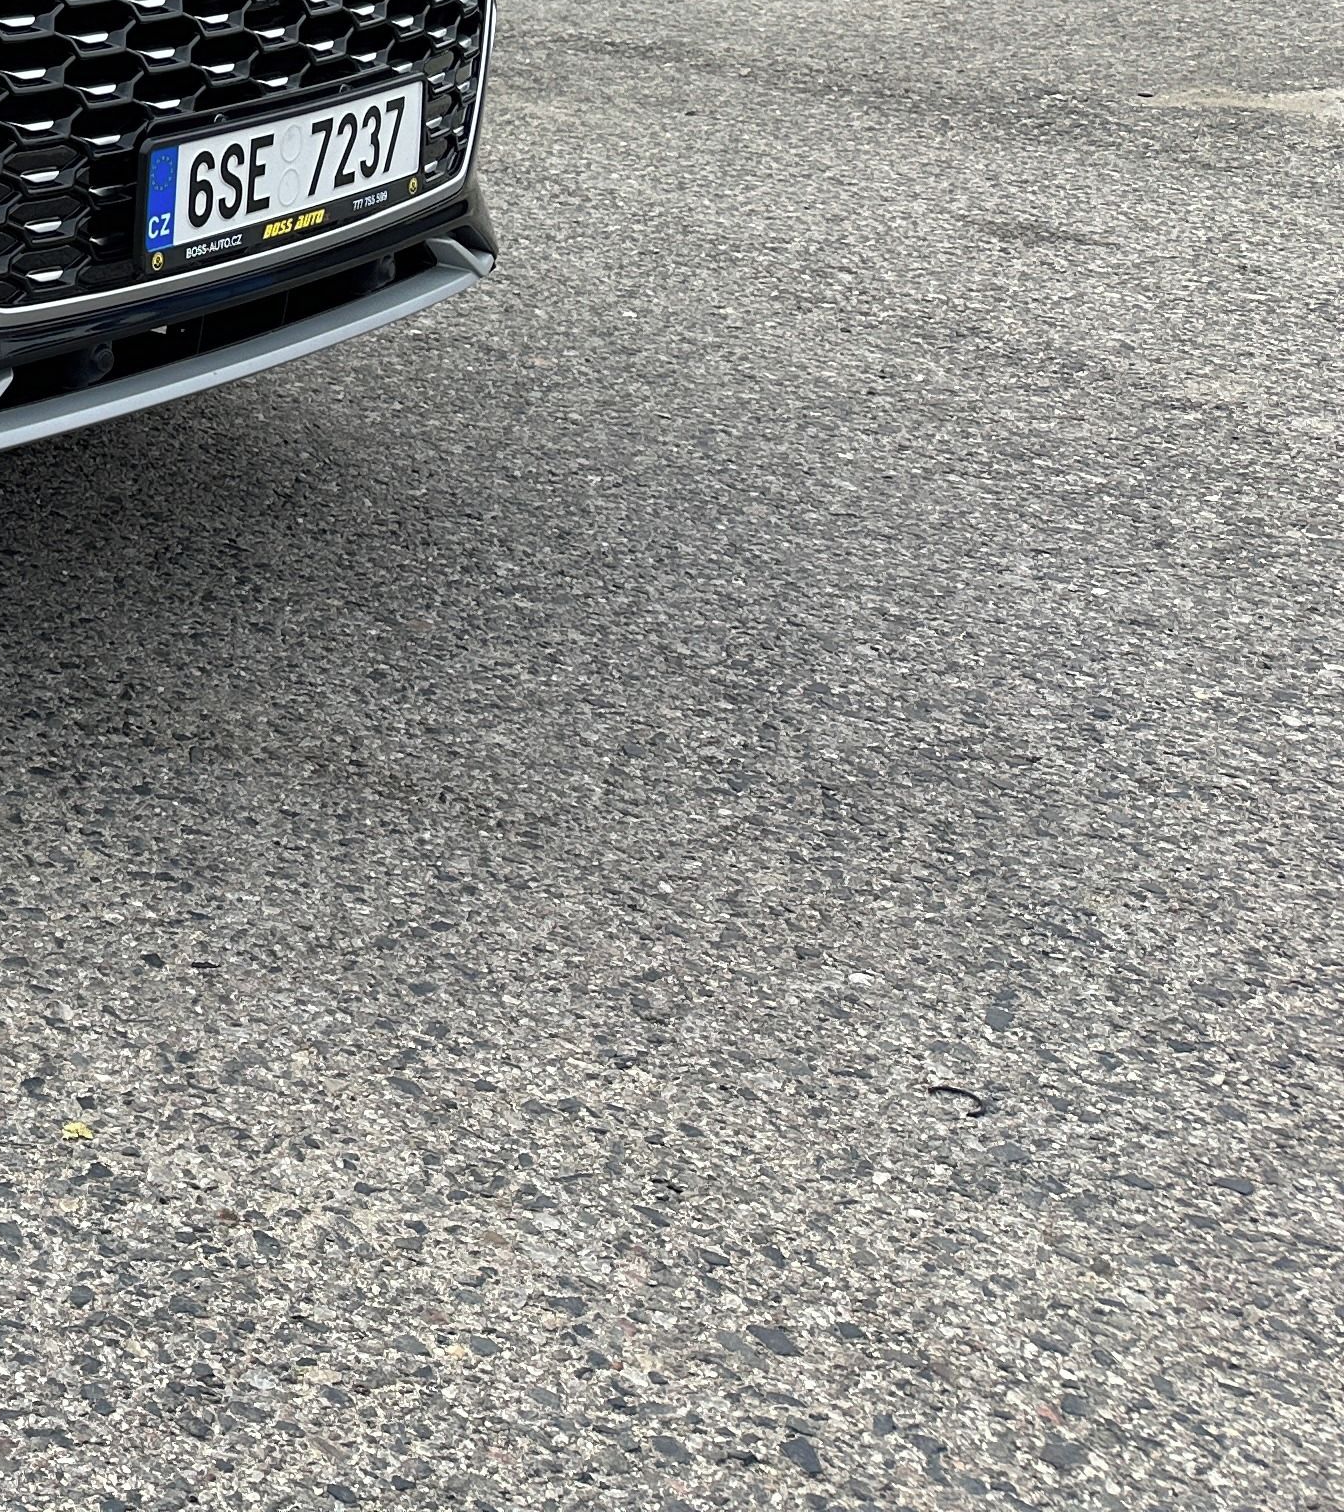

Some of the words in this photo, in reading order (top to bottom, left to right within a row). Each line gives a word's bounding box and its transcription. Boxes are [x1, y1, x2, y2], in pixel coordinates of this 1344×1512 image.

[148, 212, 171, 239] CZ
[188, 133, 274, 228] 6SE
[308, 96, 405, 197] 7237
[186, 234, 243, 259] BOSS-AUTO.CZ
[262, 218, 293, 239] BOSS
[294, 208, 326, 230] AUTO
